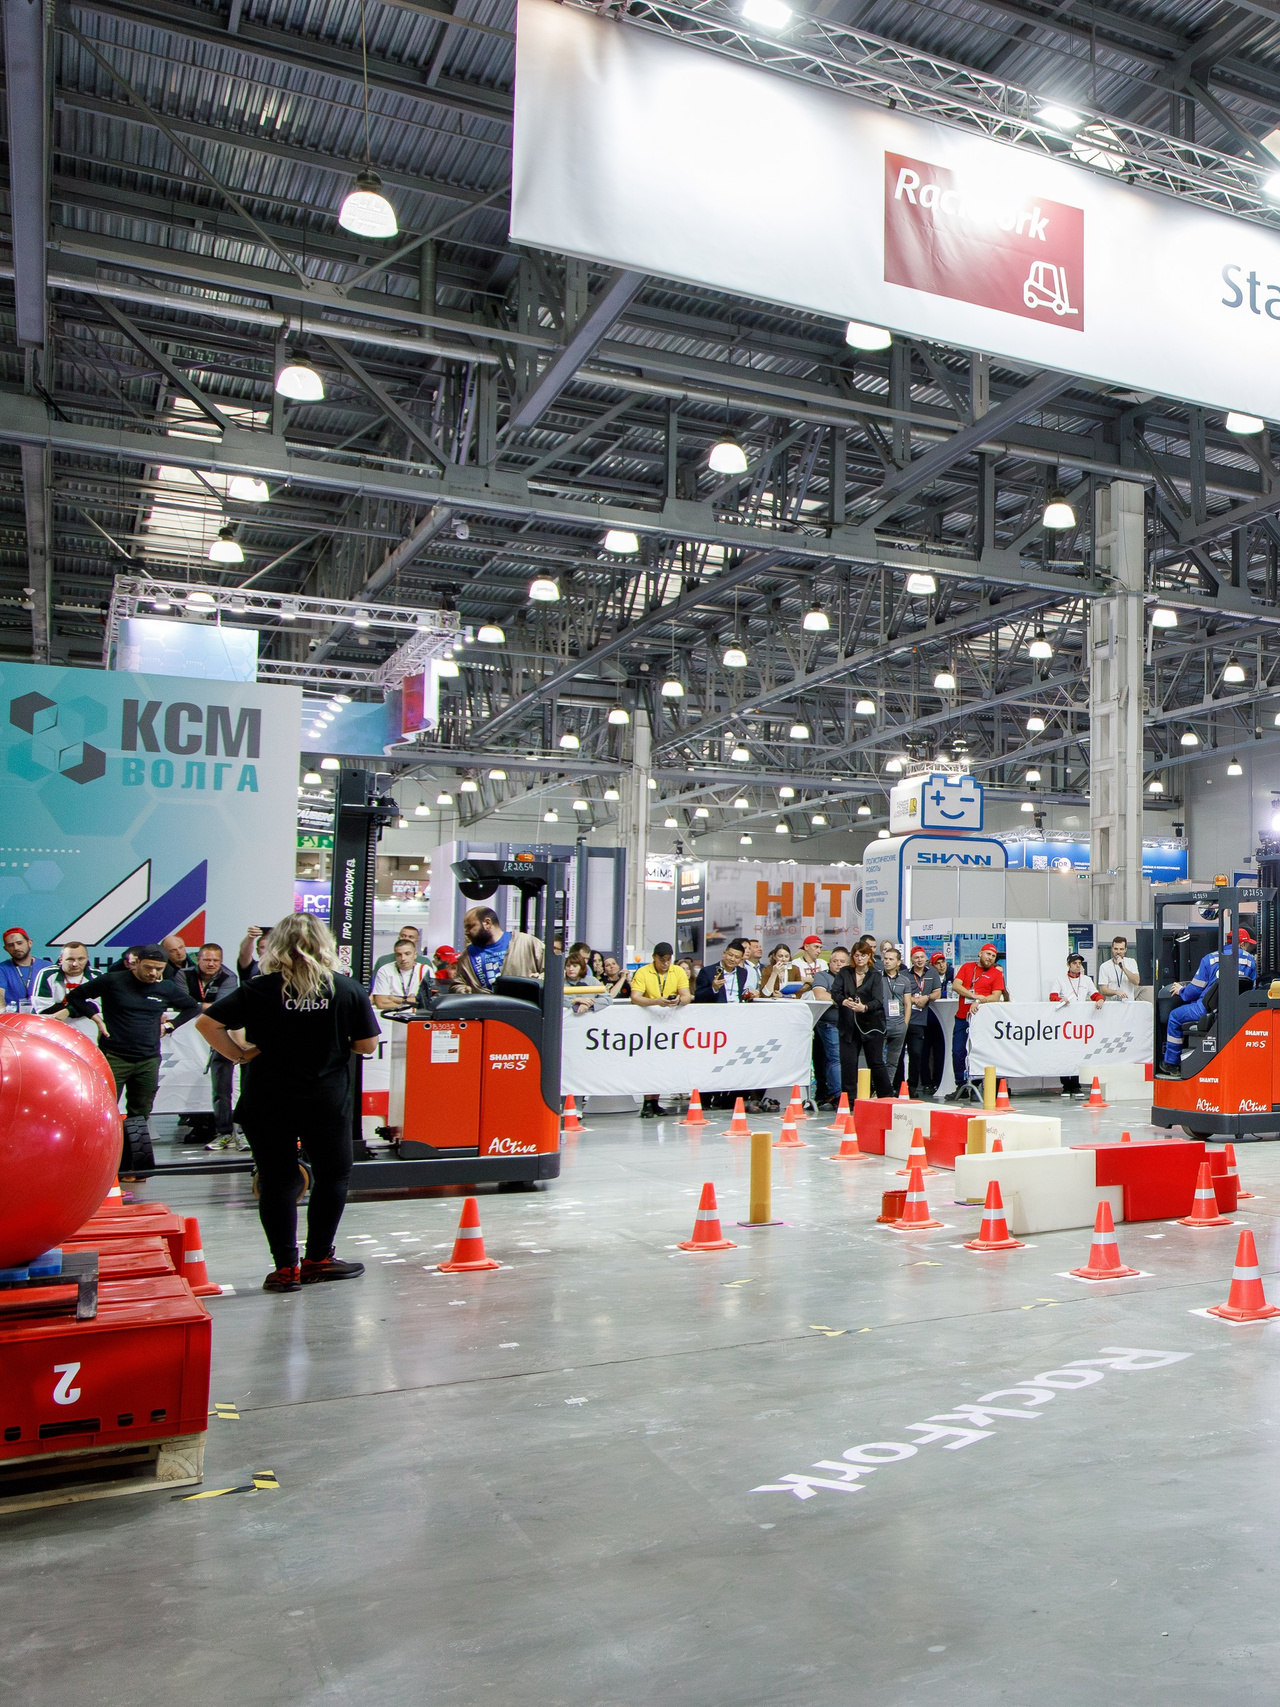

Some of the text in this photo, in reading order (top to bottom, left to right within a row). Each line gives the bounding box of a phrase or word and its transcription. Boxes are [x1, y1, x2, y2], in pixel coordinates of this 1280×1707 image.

[121, 698, 262, 759] КСМ
[122, 757, 259, 793] ВОЛГА
[343, 867, 356, 939] ПРО от РЭКФОРК
[754, 925, 825, 936] ROBOTIC
[285, 998, 329, 1012] СУДЬЯ
[585, 1025, 728, 1057] StaplerCup
[994, 1019, 1095, 1046] StaplerCup
[1245, 1029, 1269, 1037] SHANTUI
[489, 1053, 530, 1062] SHANTUI
[53, 1361, 82, 1405] 2
[749, 1345, 1195, 1500] RackFork
